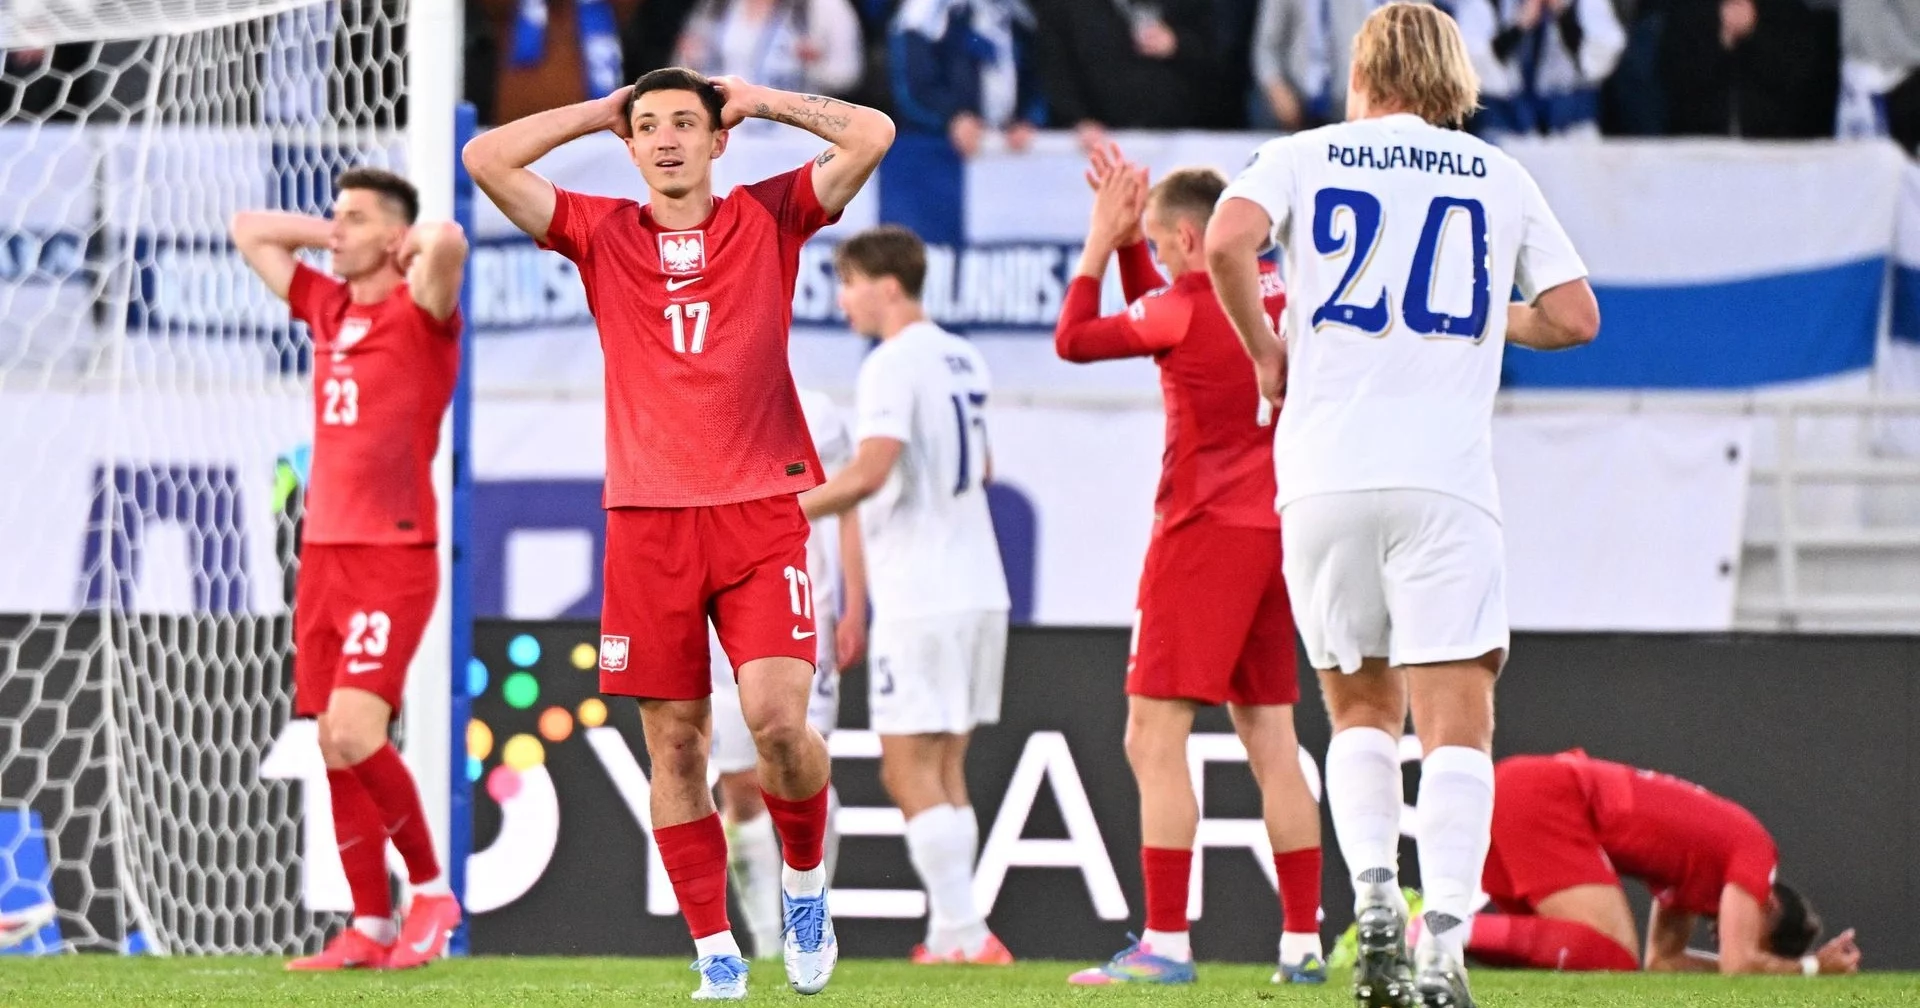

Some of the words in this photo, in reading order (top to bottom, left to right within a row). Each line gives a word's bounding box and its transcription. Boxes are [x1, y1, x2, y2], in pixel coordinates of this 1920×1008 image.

[1329, 144, 1487, 178] POHJANPALO
[1312, 187, 1493, 345] 20
[664, 301, 711, 354] 17
[323, 378, 359, 425] 23
[783, 565, 812, 620] 17
[342, 609, 392, 657] 23
